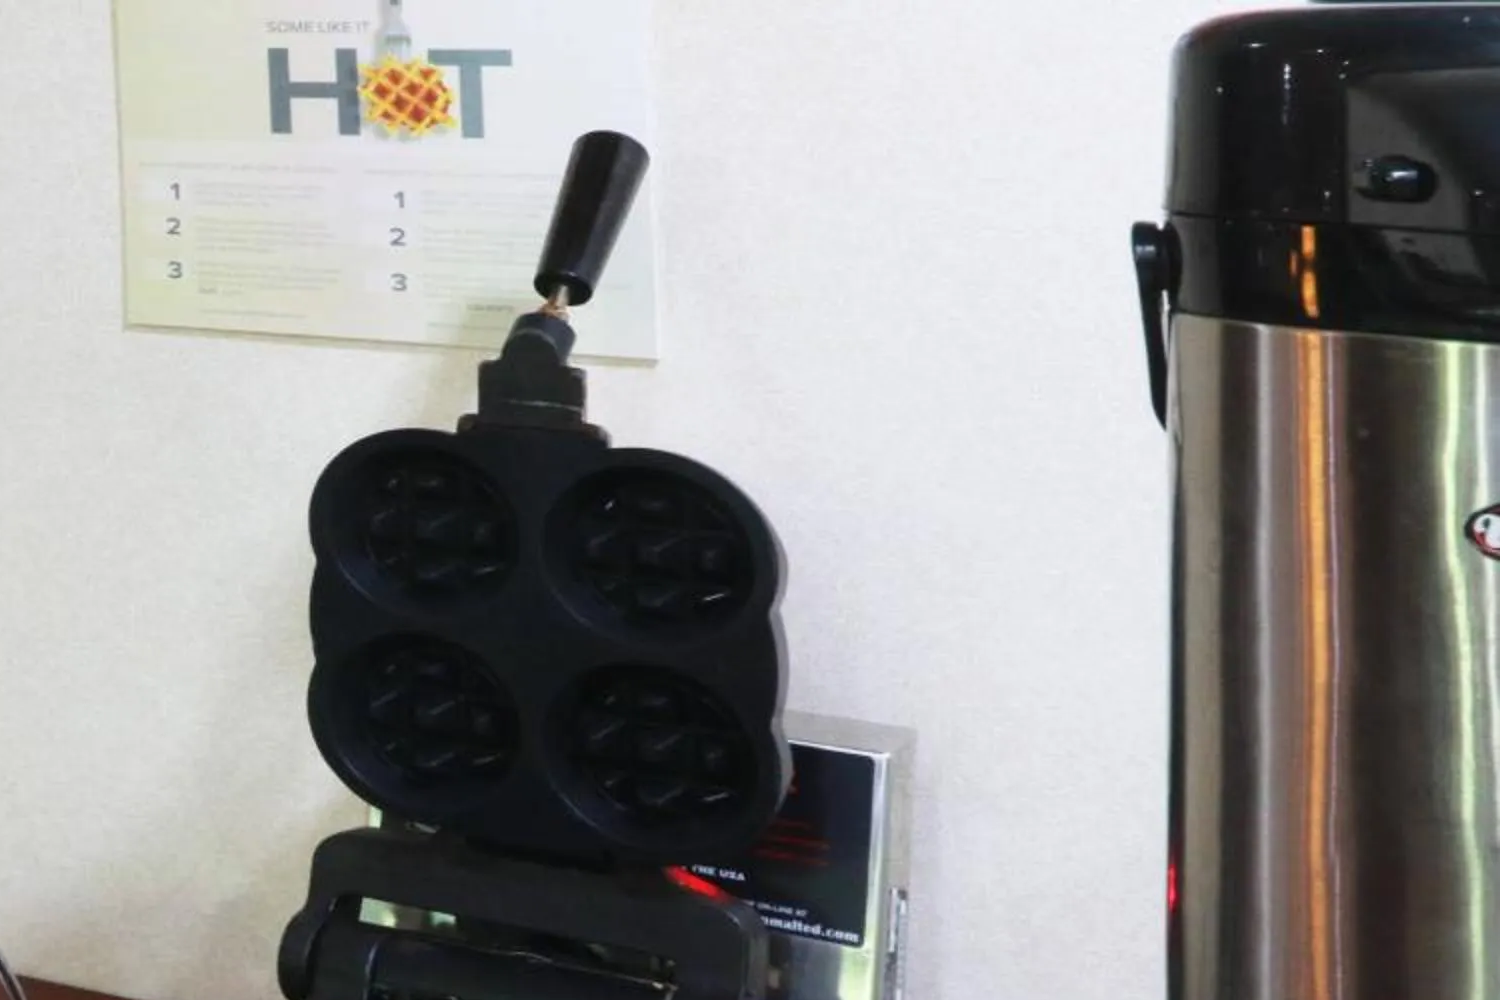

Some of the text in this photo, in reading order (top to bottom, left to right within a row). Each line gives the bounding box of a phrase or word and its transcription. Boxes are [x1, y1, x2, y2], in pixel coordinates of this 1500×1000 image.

[265, 20, 370, 33] SOME LIKE IT
[169, 182, 181, 200] 1
[393, 190, 405, 209] 1
[165, 217, 181, 235] 2
[389, 227, 406, 246] 2
[167, 260, 182, 279] 3
[391, 273, 407, 292] 3
